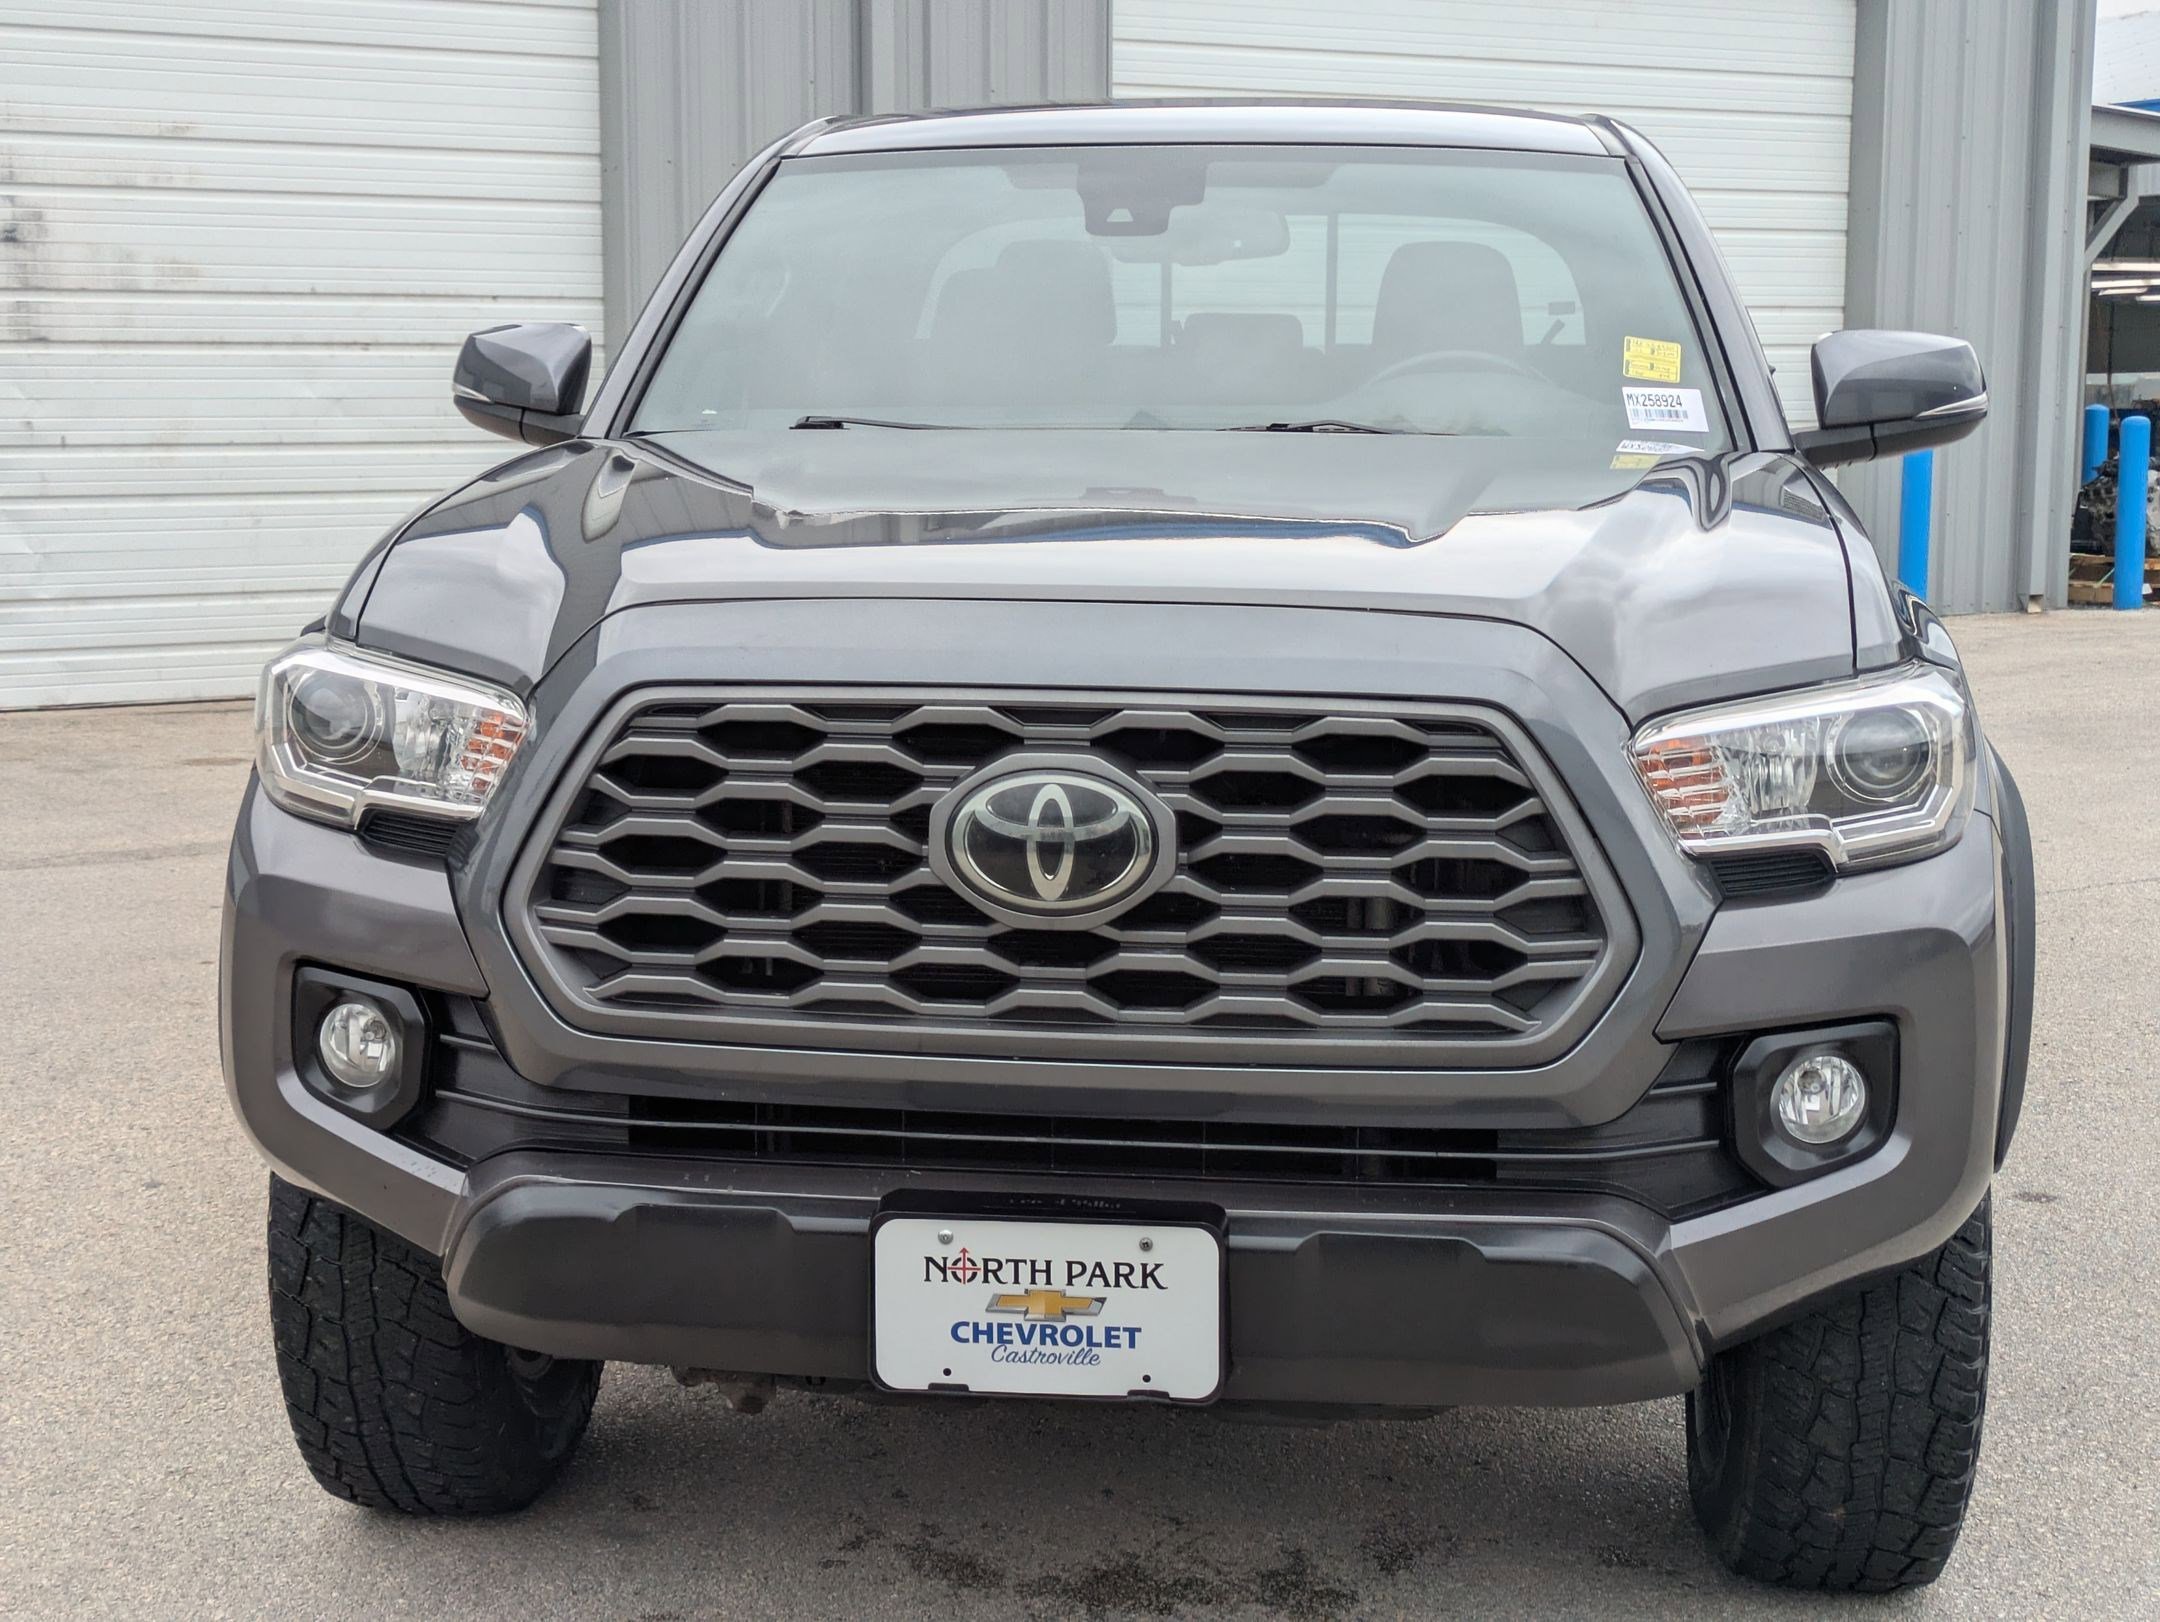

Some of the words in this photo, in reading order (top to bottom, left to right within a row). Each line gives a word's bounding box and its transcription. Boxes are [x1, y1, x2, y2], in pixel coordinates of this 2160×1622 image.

[1626, 393, 1682, 408] MX258924
[923, 1255, 1053, 1287] NORTH
[1065, 1260, 1168, 1290] PARK
[950, 1321, 1142, 1349] CHEVROLET
[990, 1343, 1102, 1367] Castroville
